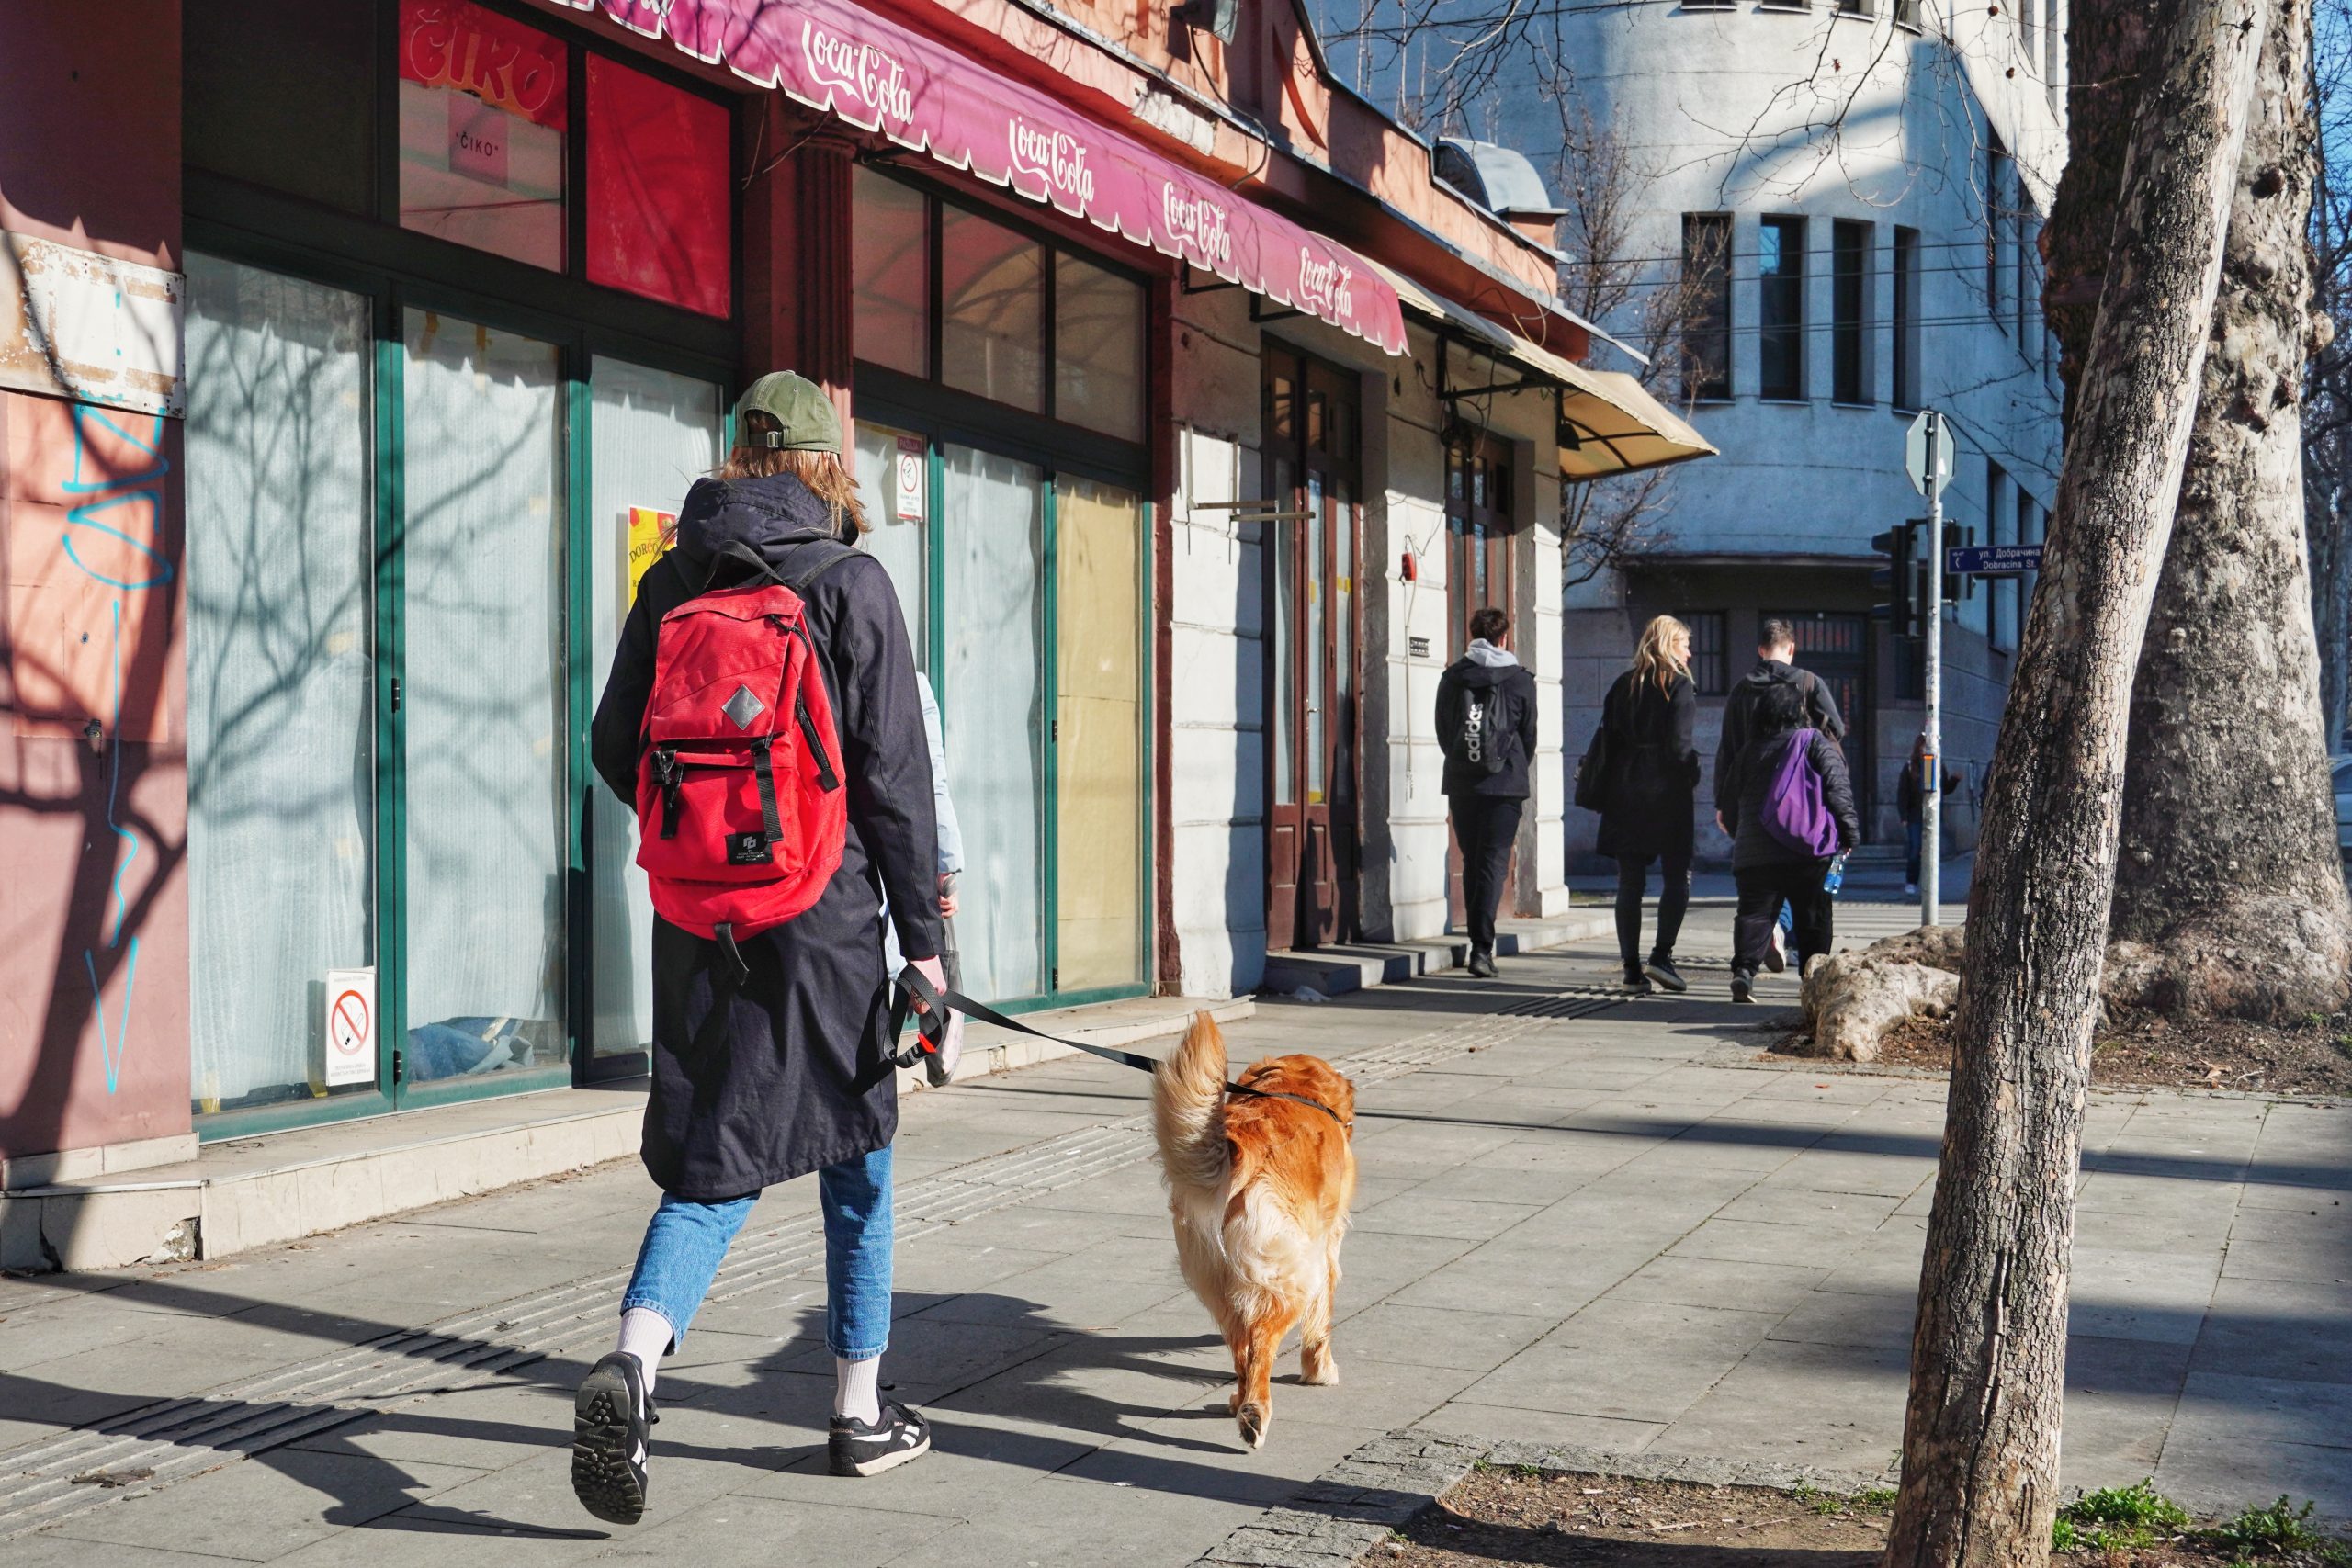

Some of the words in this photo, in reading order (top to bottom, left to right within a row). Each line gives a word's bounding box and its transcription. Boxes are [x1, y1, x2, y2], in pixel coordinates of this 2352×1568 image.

[410, 9, 555, 112] ČIKO
[802, 19, 915, 125] Coca-Cola
[1009, 116, 1095, 202] Coca-Cola
[1163, 181, 1232, 263] Coca-Cola
[1299, 246, 1352, 318] Coca-Cola
[1983, 560, 2022, 570] Dobracina
[1995, 548, 2041, 559] Добрачина
[1464, 703, 1484, 762] adidas
